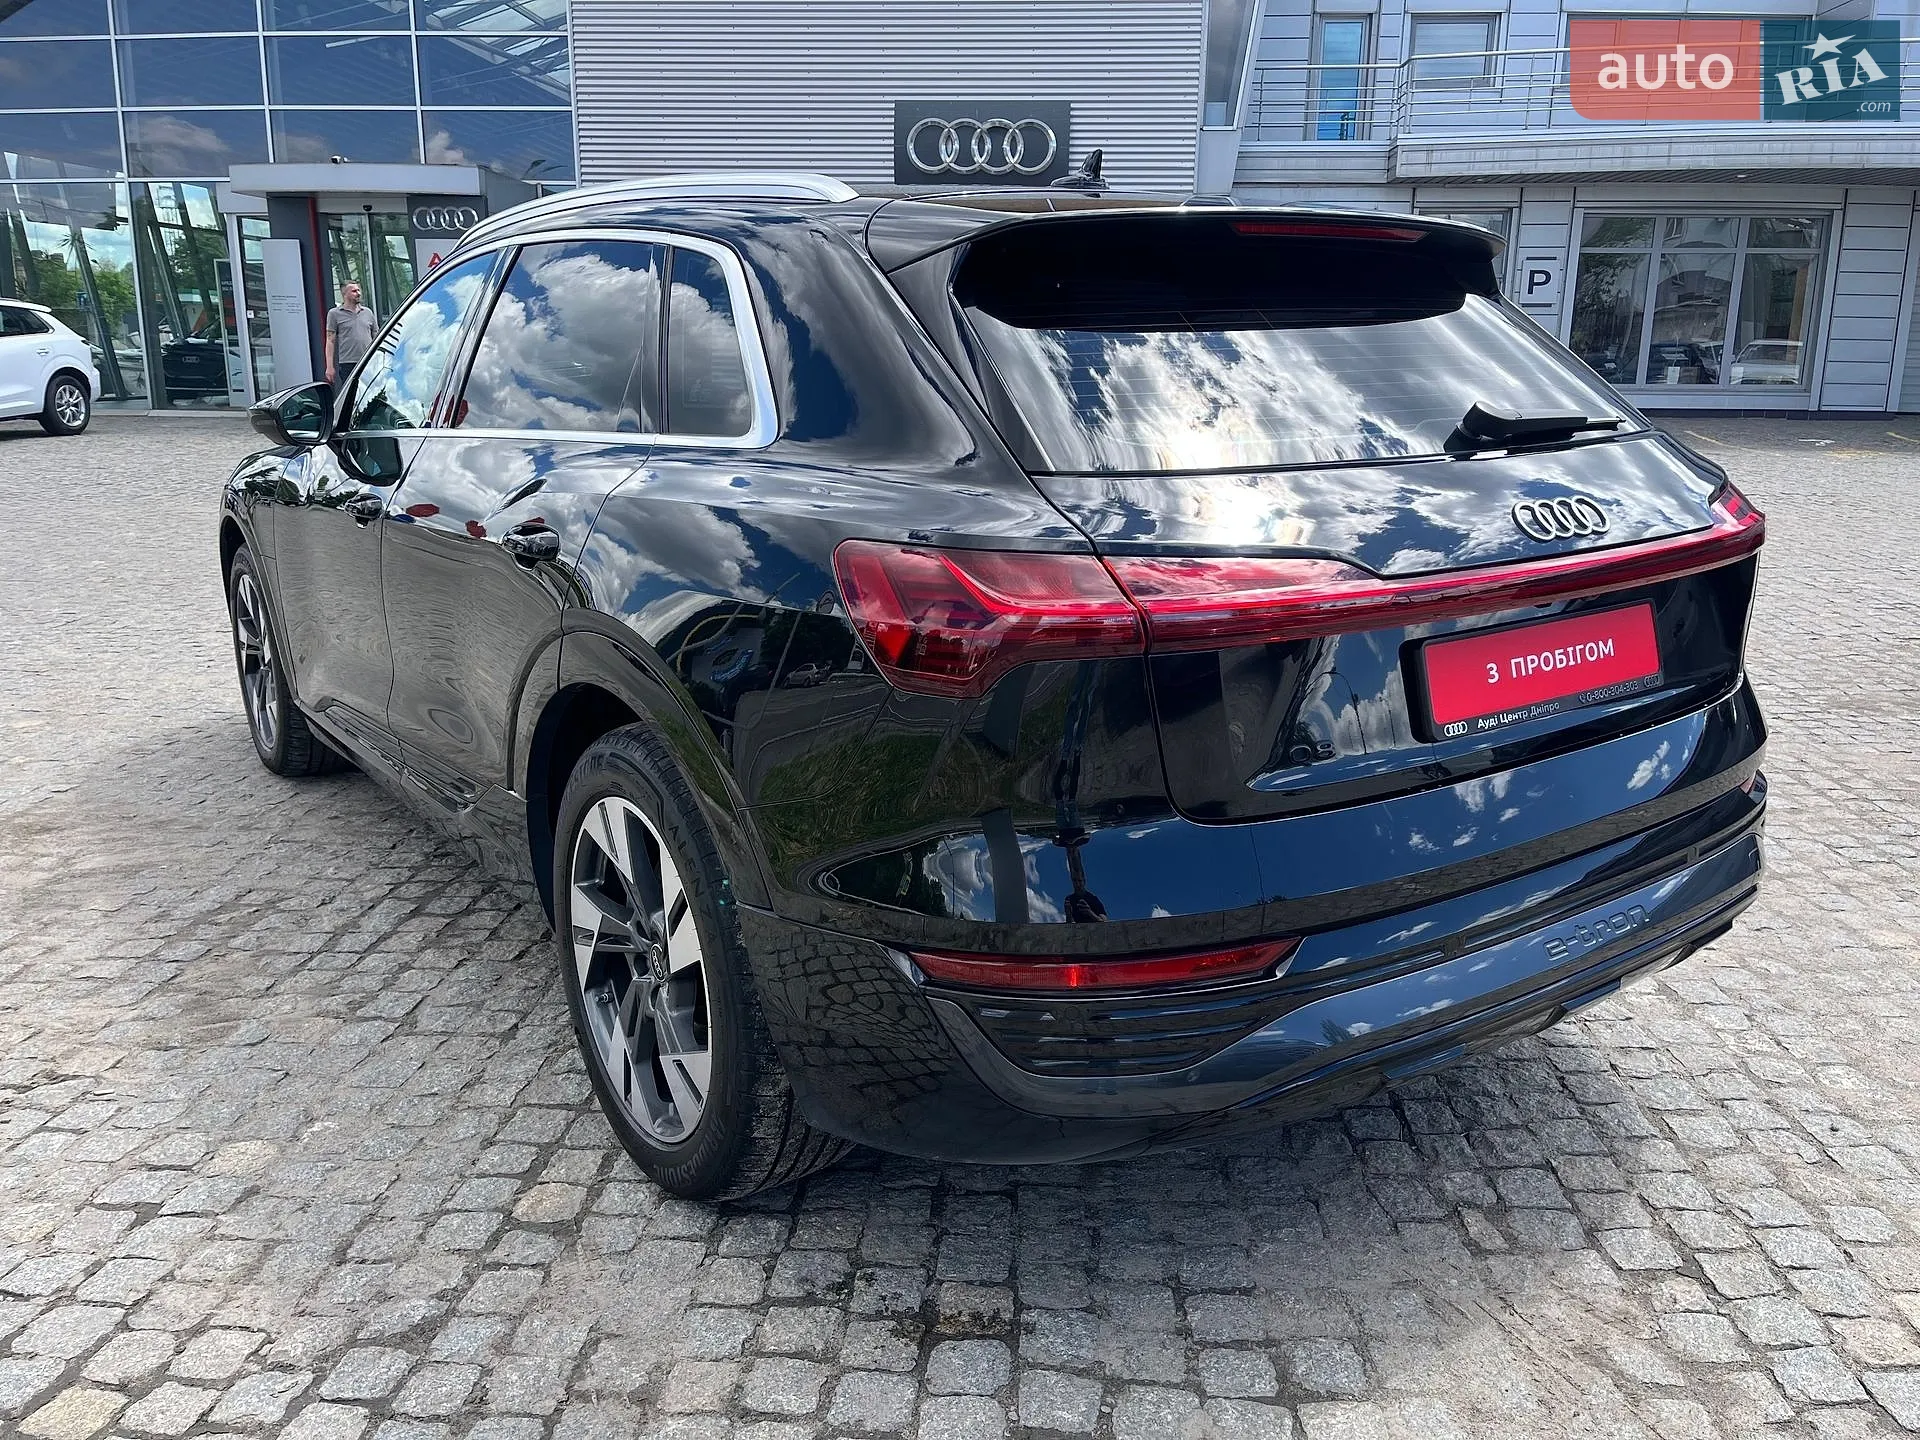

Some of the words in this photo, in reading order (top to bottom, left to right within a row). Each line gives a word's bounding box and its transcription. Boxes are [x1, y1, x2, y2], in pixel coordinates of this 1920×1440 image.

[1527, 269, 1552, 295] P
[1510, 638, 1615, 679] ПРОБІГОМ
[1477, 715, 1498, 730] Ауді
[1499, 709, 1528, 725] Центр
[1530, 702, 1560, 717] Дніпро
[1543, 904, 1650, 961] e-tron
